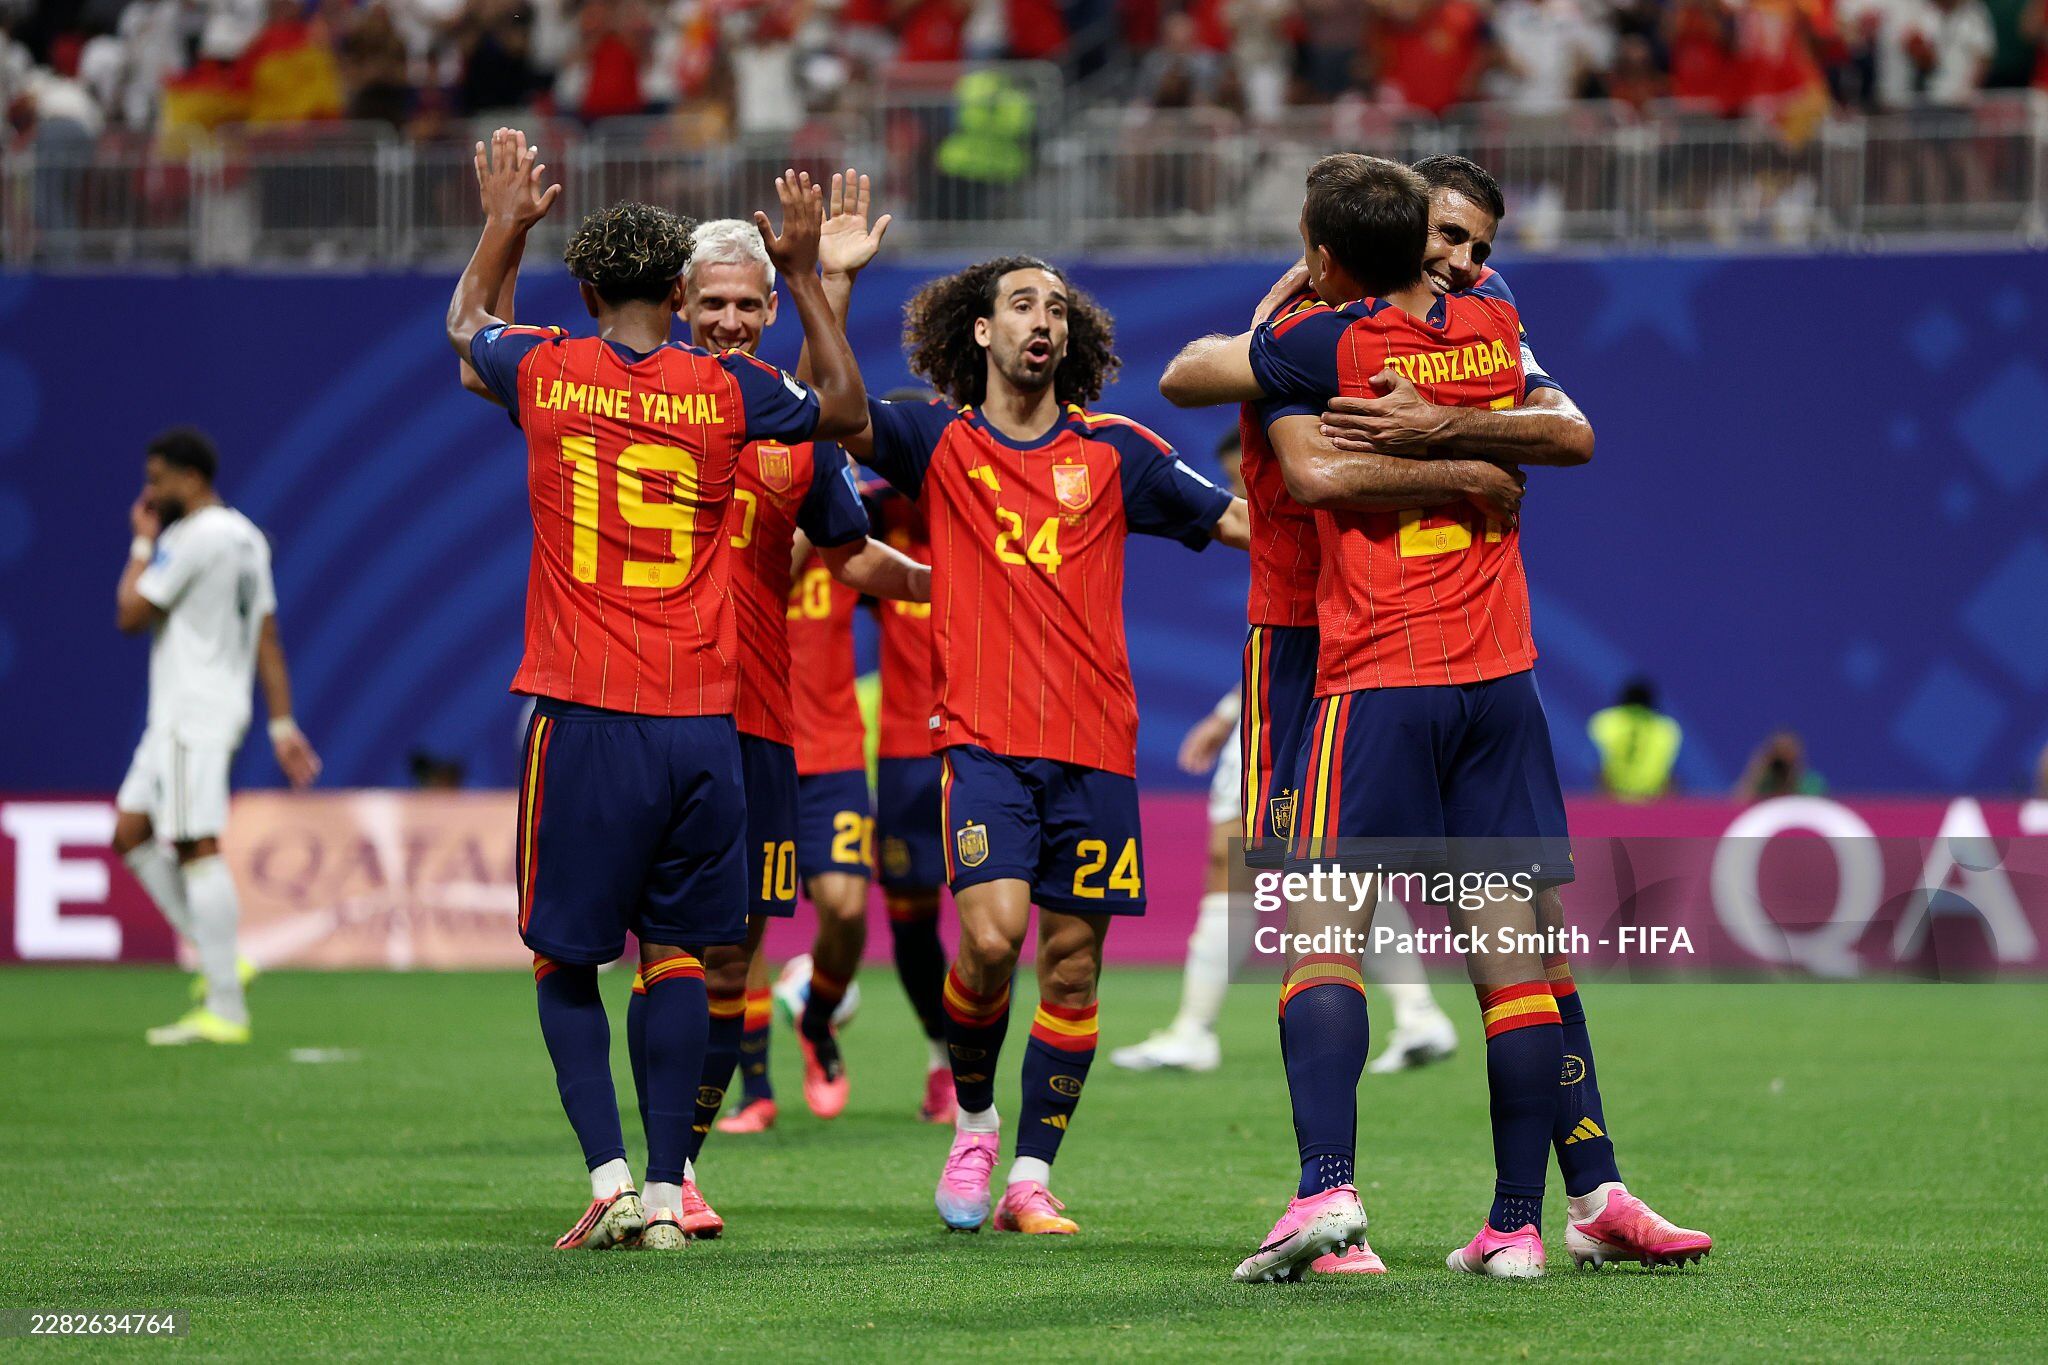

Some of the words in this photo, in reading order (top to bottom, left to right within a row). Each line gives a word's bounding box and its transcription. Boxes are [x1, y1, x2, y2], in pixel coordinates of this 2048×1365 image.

[535, 377, 631, 419] LAMINE
[639, 392, 725, 425] YAMAL
[560, 435, 699, 588] 19
[995, 506, 1062, 574] 24
[761, 840, 796, 900] 10
[1072, 838, 1141, 898] 24
